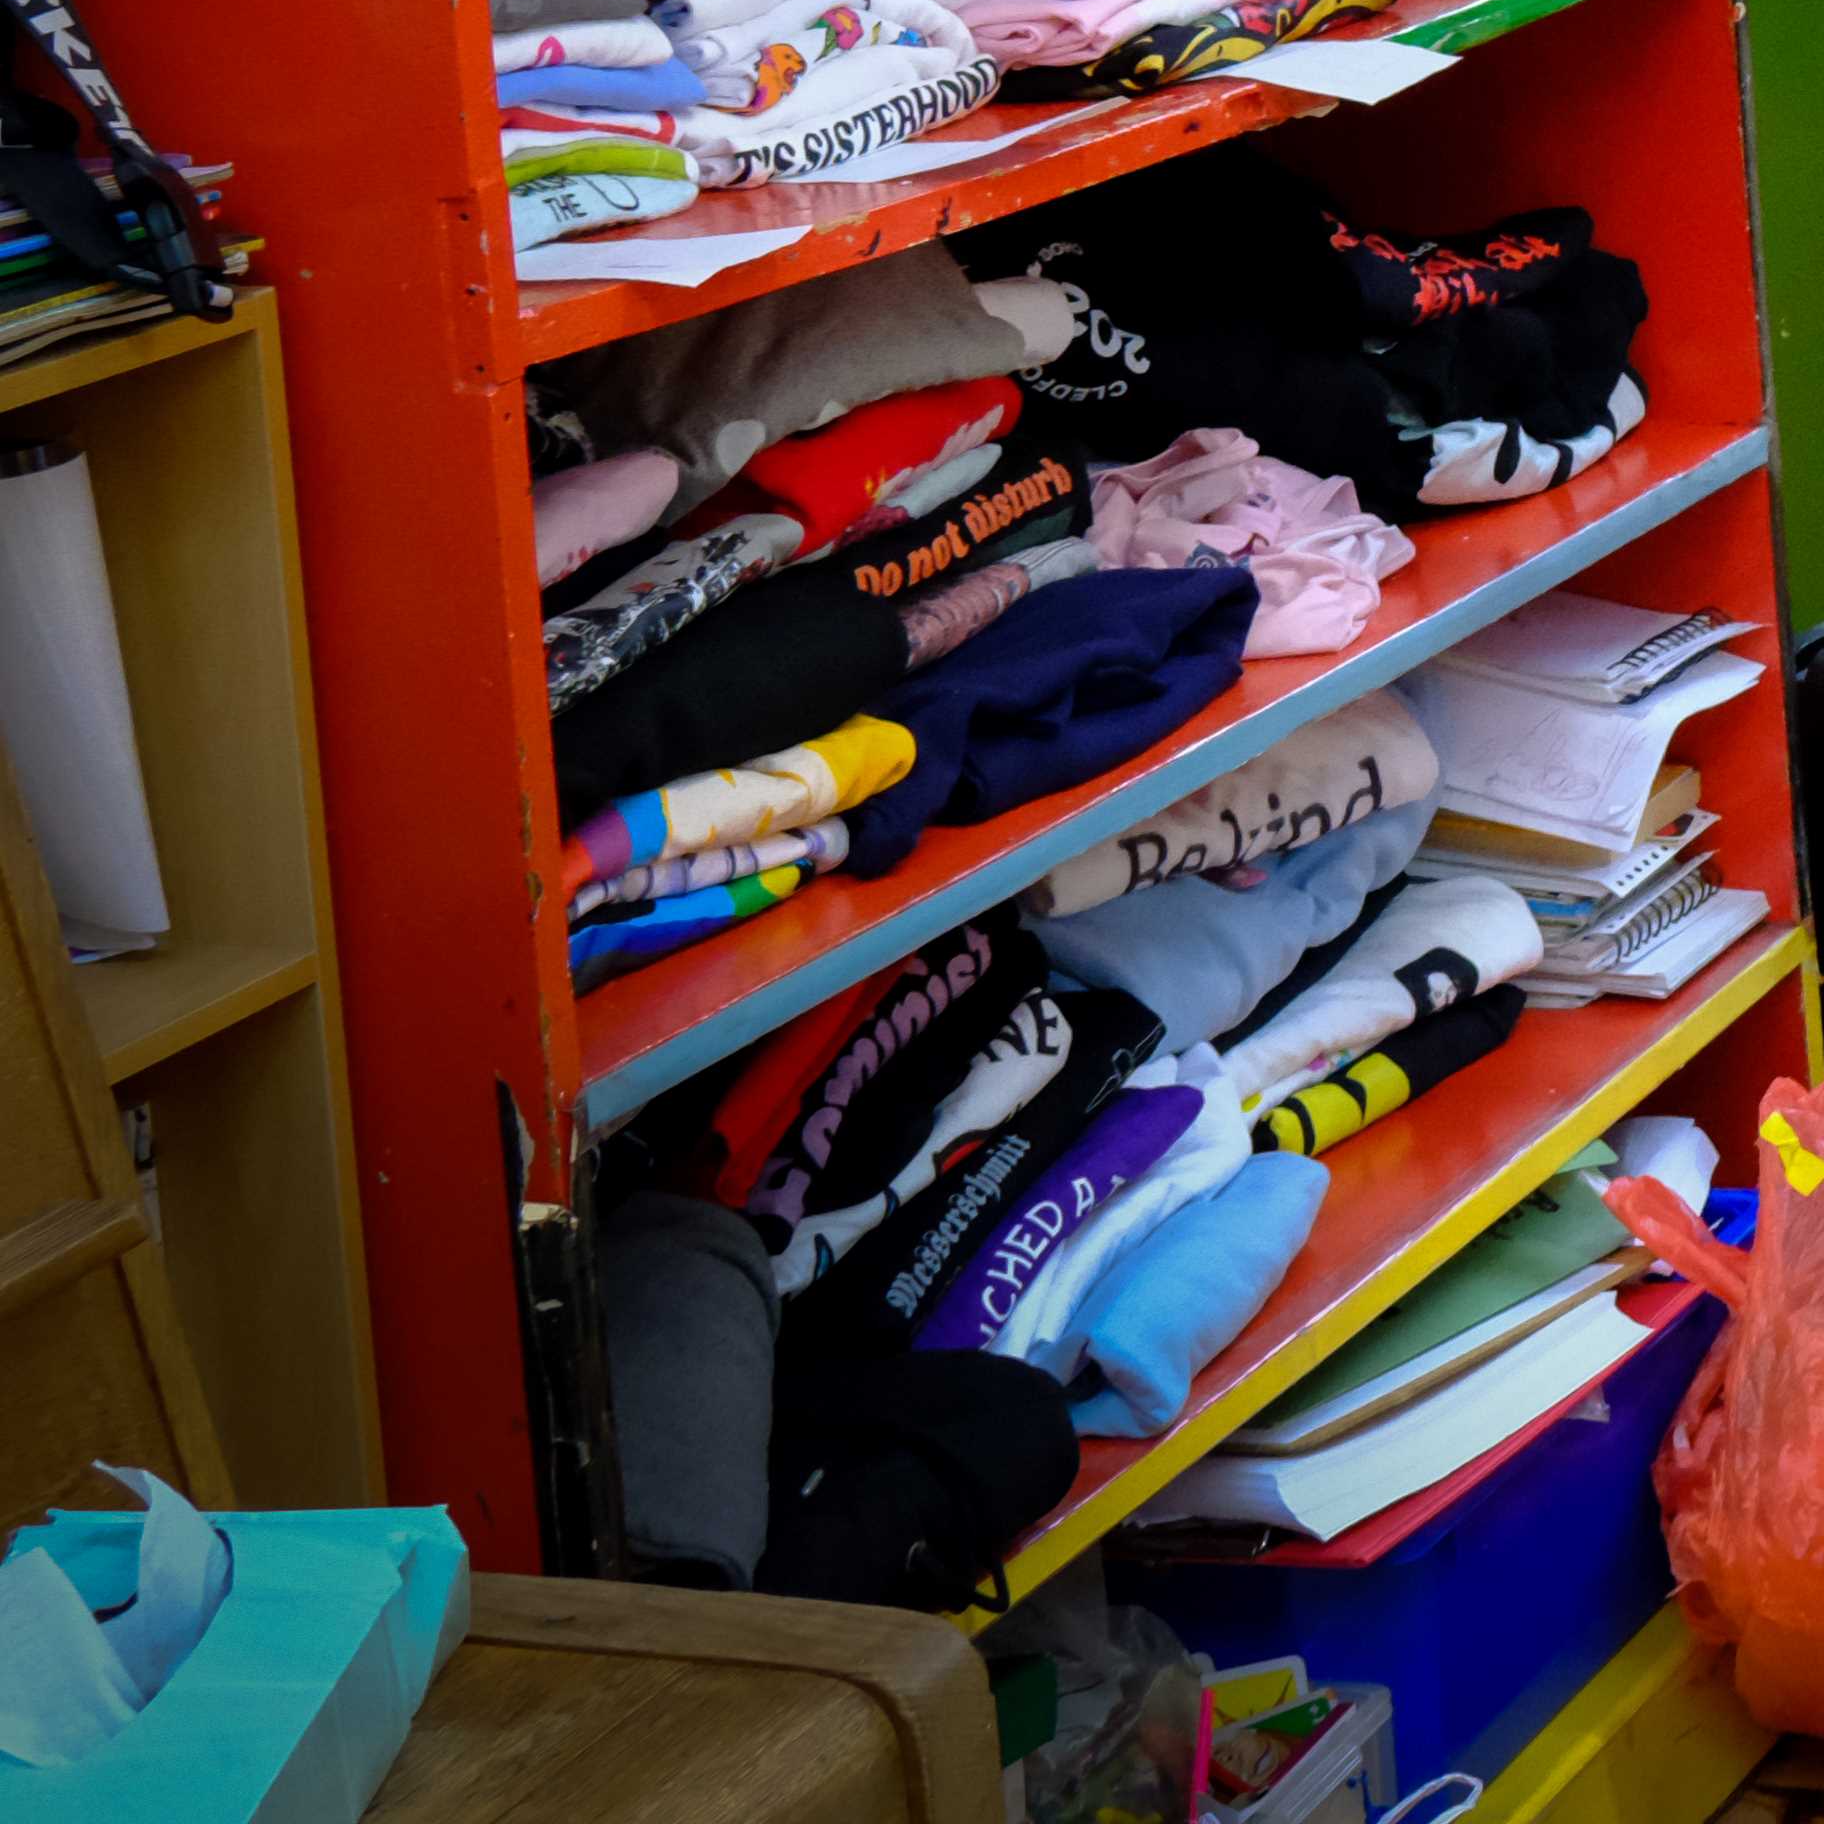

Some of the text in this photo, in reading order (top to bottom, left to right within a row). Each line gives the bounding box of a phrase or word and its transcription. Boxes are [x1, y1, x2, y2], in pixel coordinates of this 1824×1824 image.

[798, 56, 1001, 176] SISTERHOOD
[546, 192, 589, 224] THE
[854, 456, 1074, 599] Do not disturb
